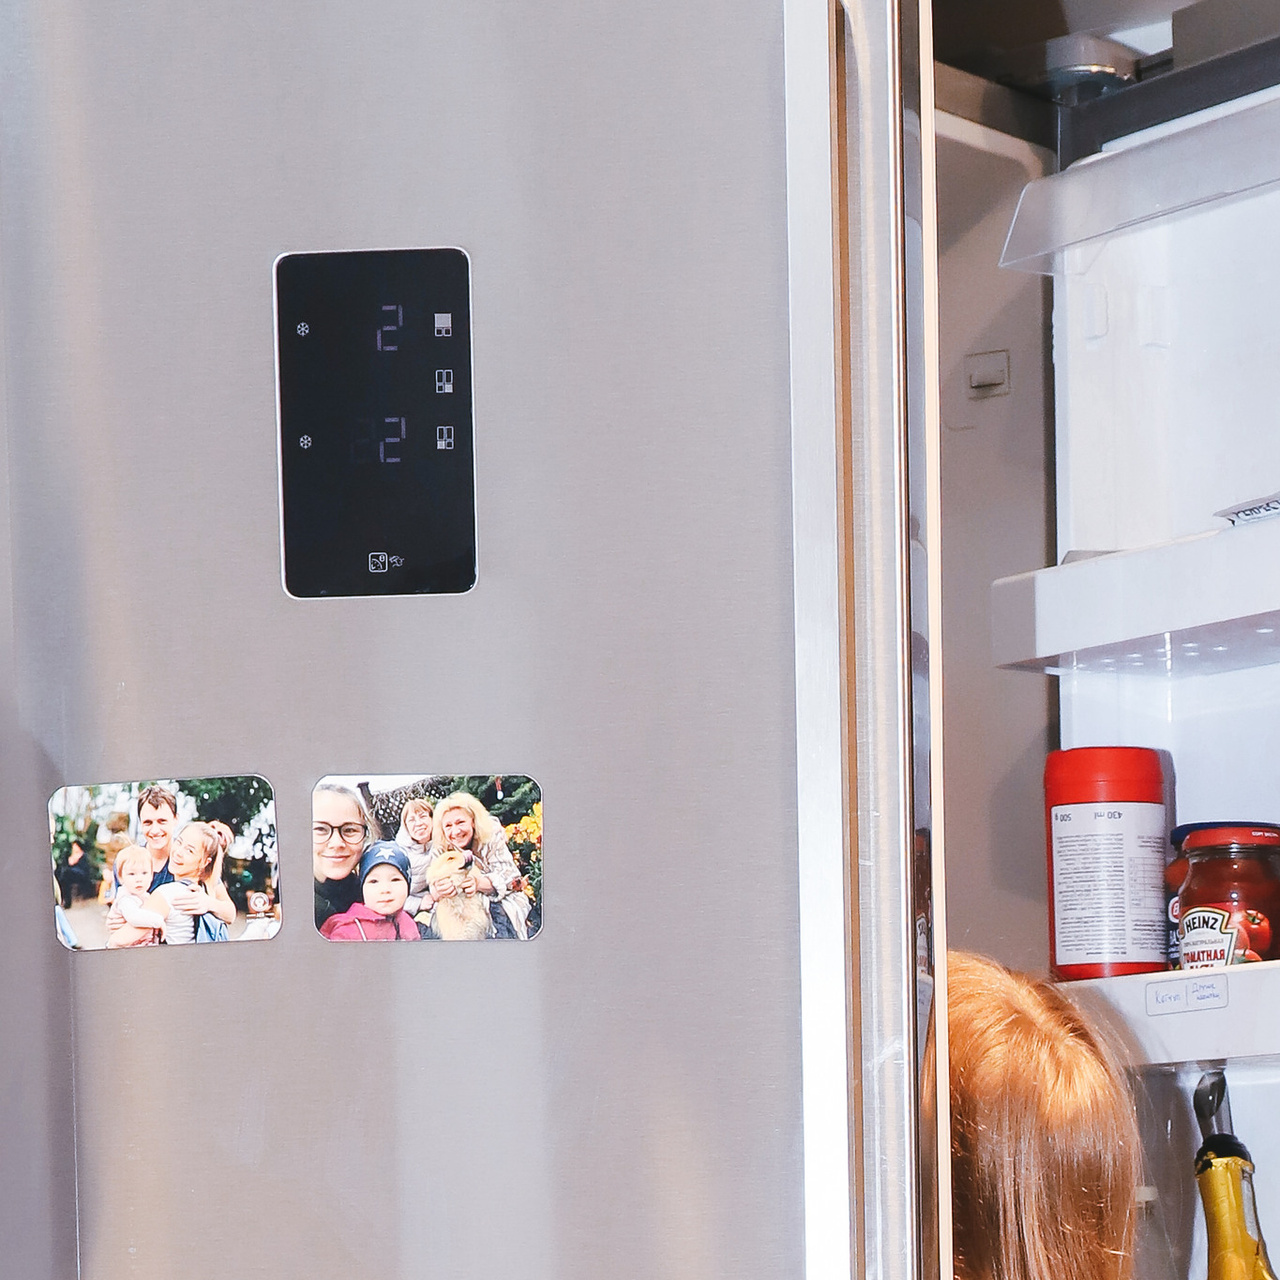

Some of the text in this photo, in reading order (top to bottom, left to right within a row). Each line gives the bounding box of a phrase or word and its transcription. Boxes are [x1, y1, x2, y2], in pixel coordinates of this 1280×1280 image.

[376, 304, 403, 352] 2
[379, 416, 406, 463] 2
[1107, 810, 1123, 820] 430
[1185, 915, 1219, 934] HEINZ
